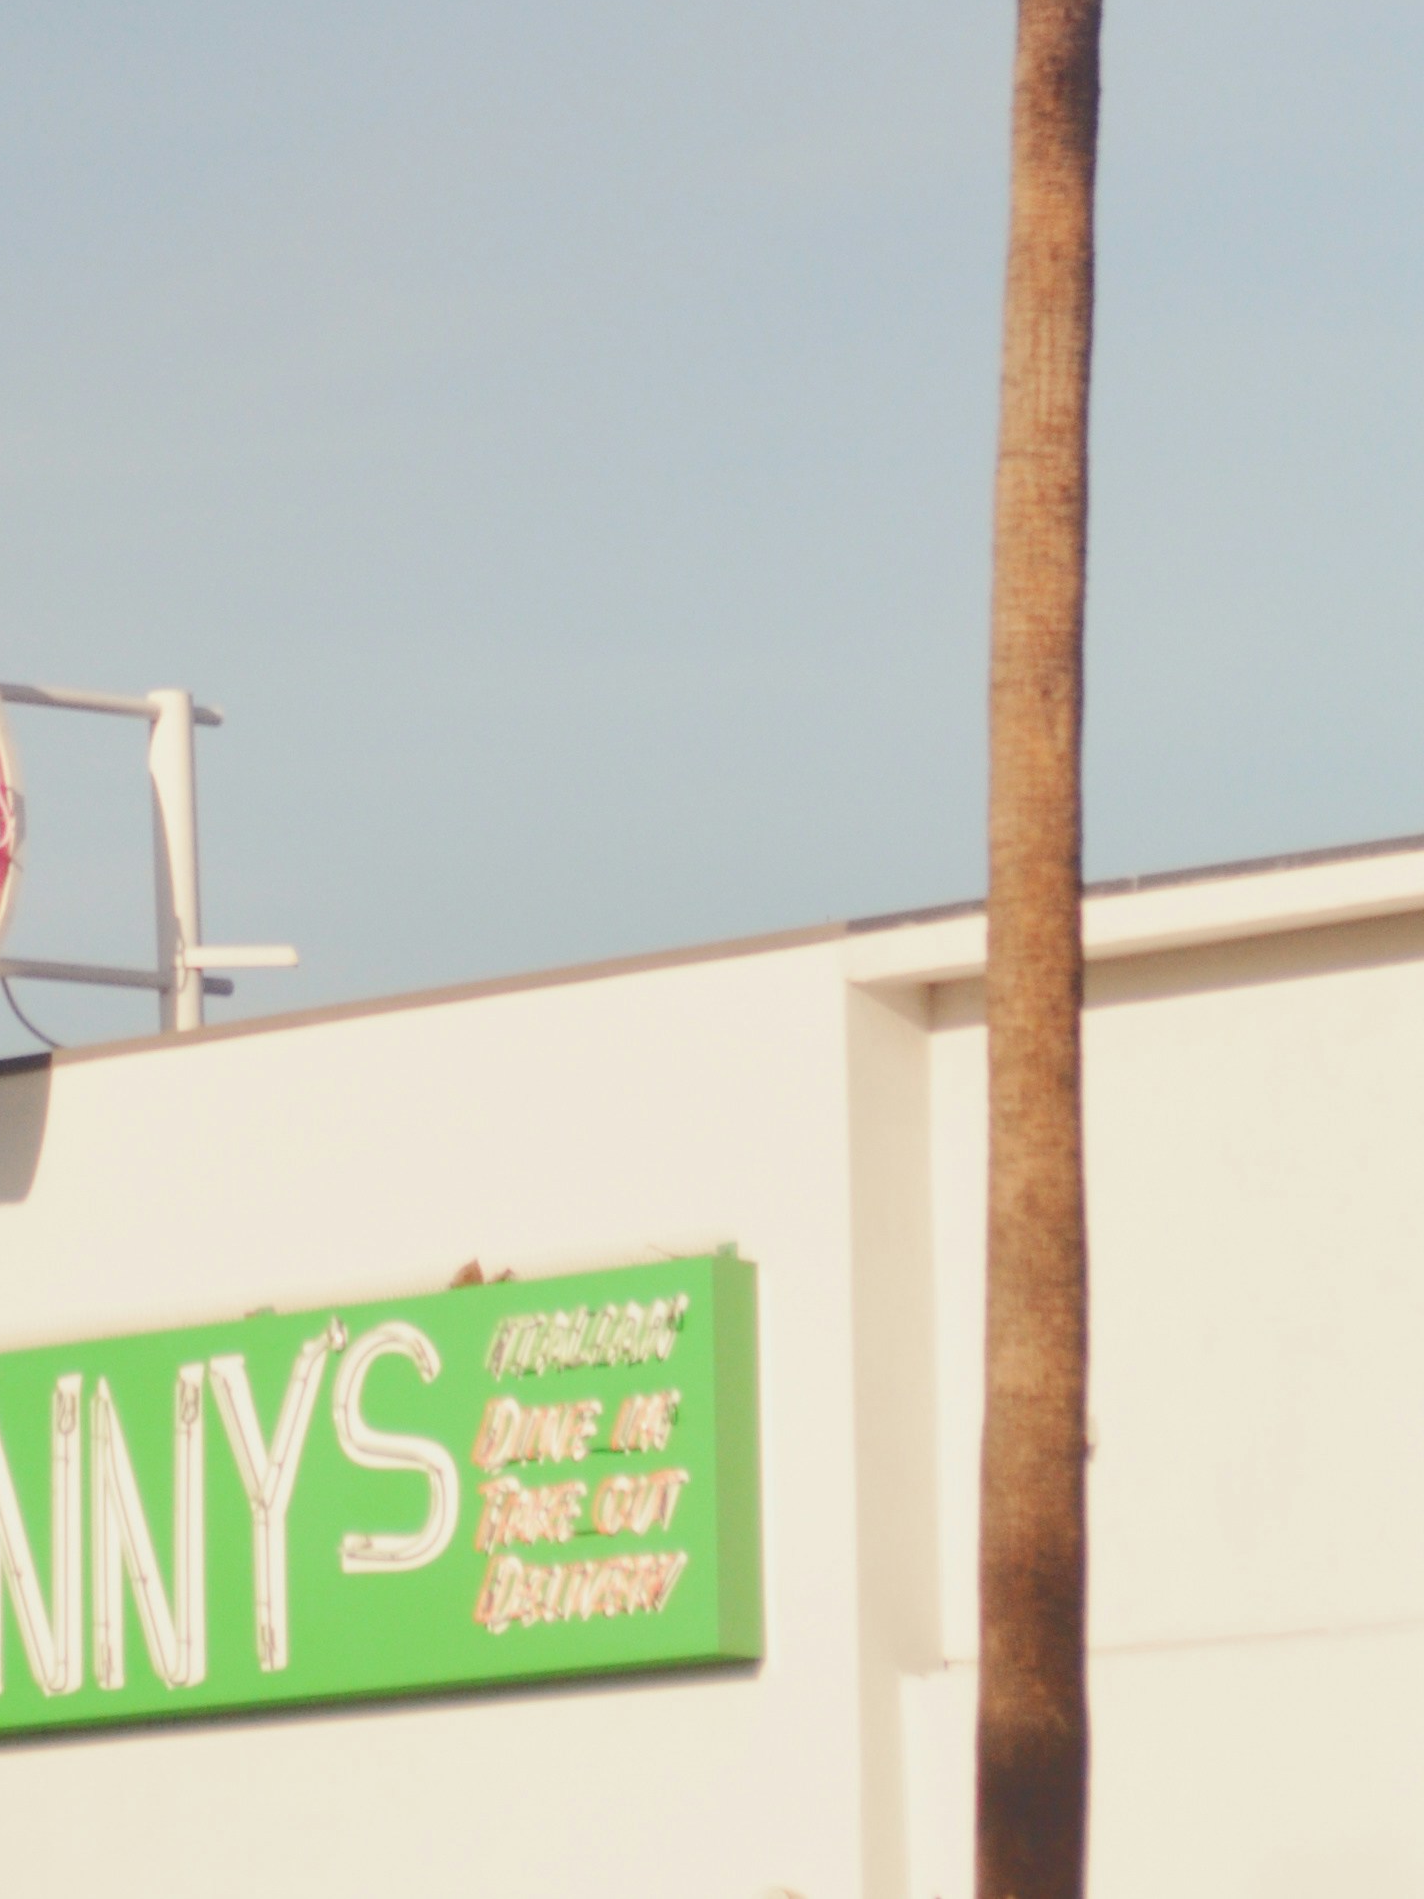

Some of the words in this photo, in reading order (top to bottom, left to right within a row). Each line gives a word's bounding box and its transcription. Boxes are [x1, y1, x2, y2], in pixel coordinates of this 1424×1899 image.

[473, 1397, 602, 1472] DINE
[611, 1390, 680, 1452] IN
[476, 1477, 587, 1553] TAKE
[593, 1469, 688, 1535] OUT
